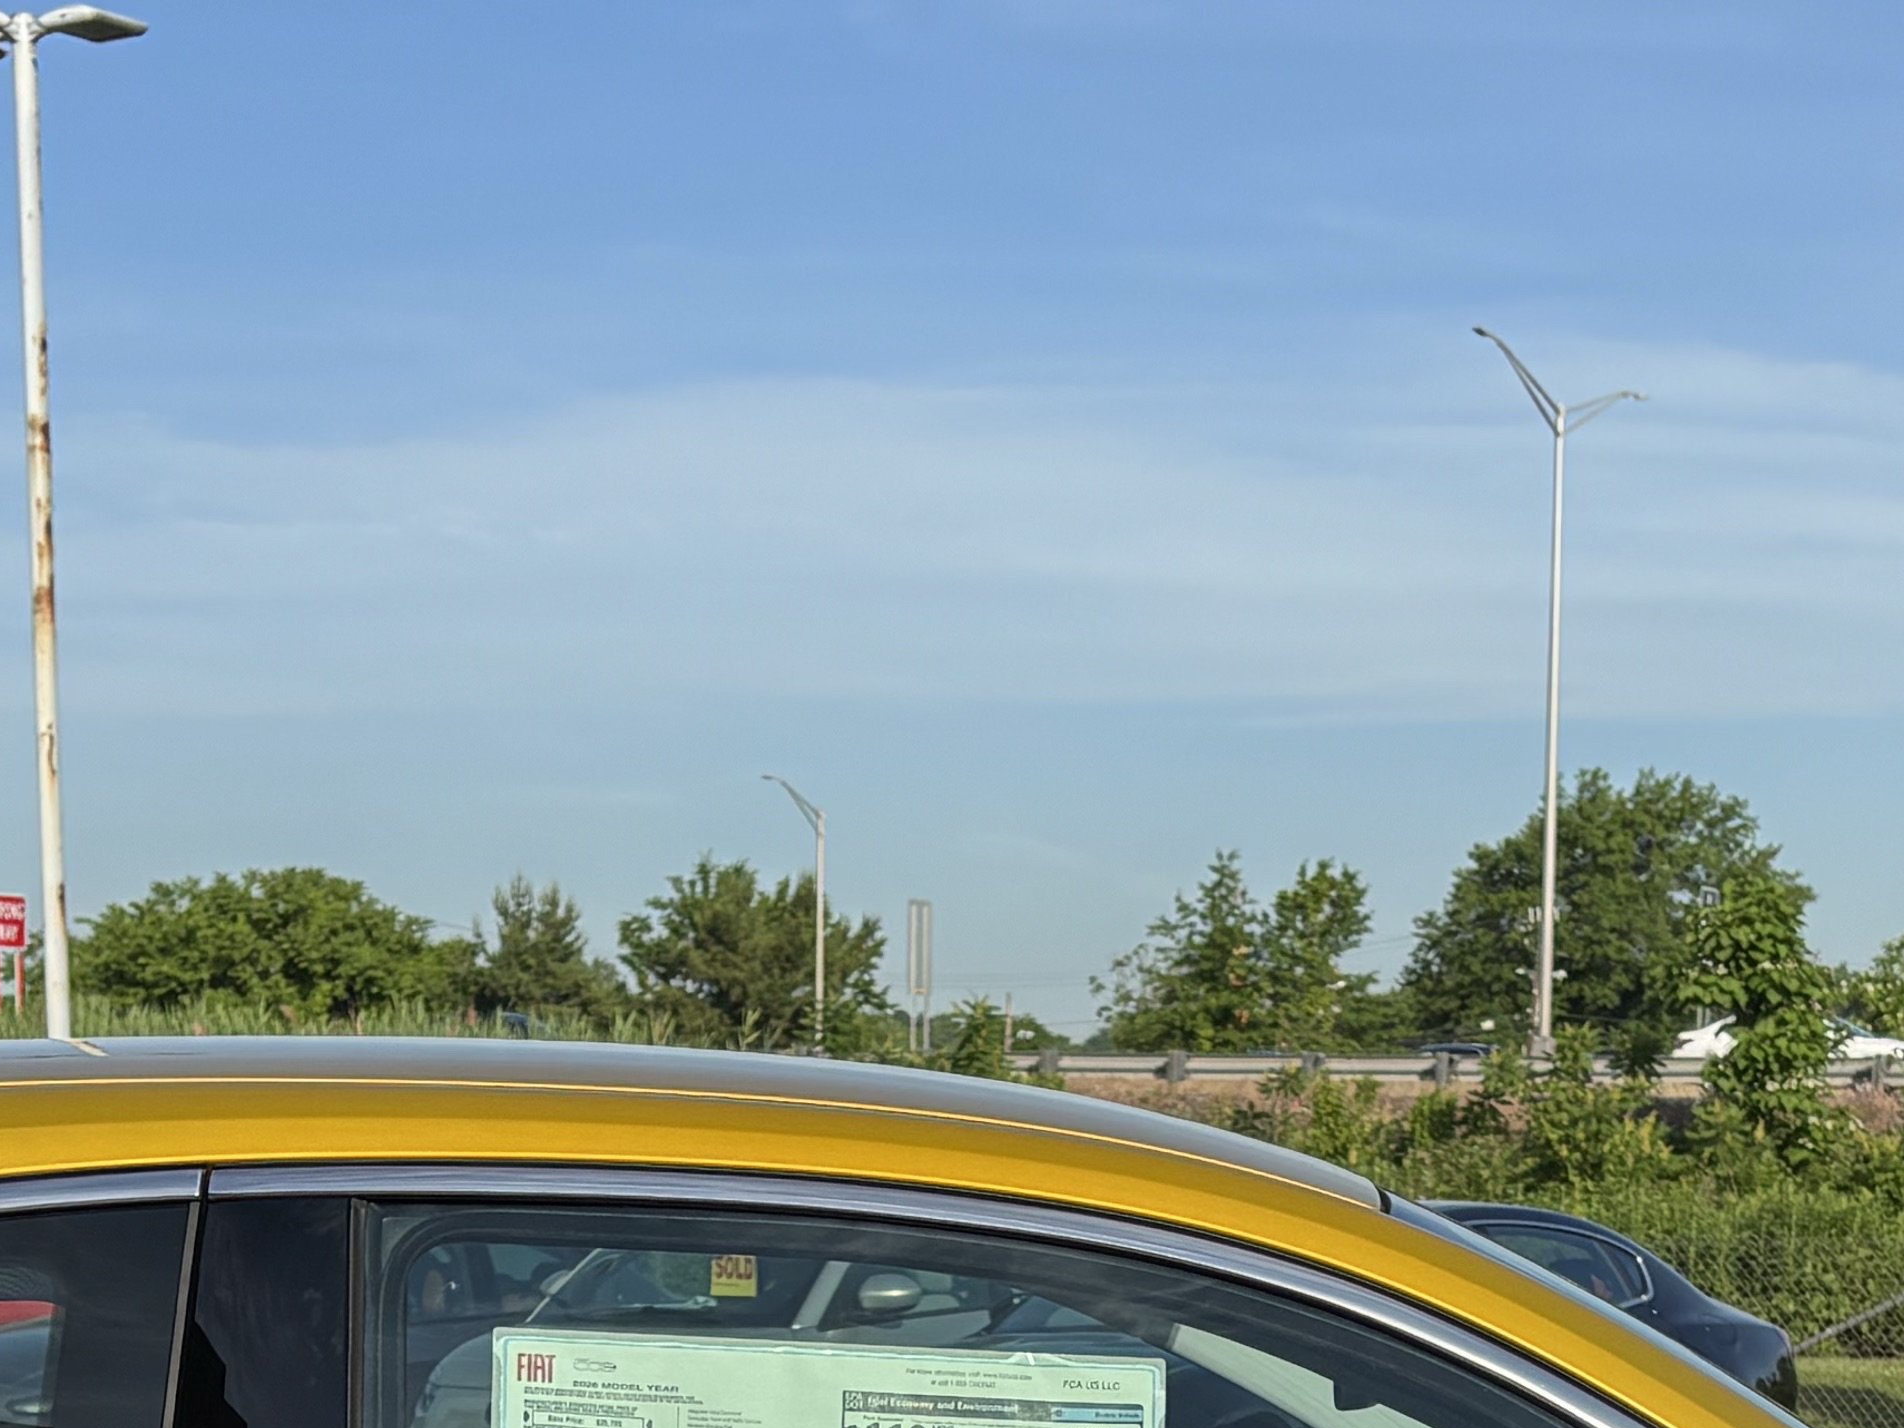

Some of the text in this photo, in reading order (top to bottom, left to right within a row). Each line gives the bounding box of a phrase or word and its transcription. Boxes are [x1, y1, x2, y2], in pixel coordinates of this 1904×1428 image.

[715, 1256, 753, 1280] SOLD
[517, 1353, 556, 1384] FIAT
[573, 1380, 680, 1393] 2026 MODEL YEAR
[1063, 1380, 1083, 1390] FCA
[1101, 1382, 1121, 1391] LLC
[890, 1398, 935, 1410] Economy
[937, 1400, 955, 1410] and
